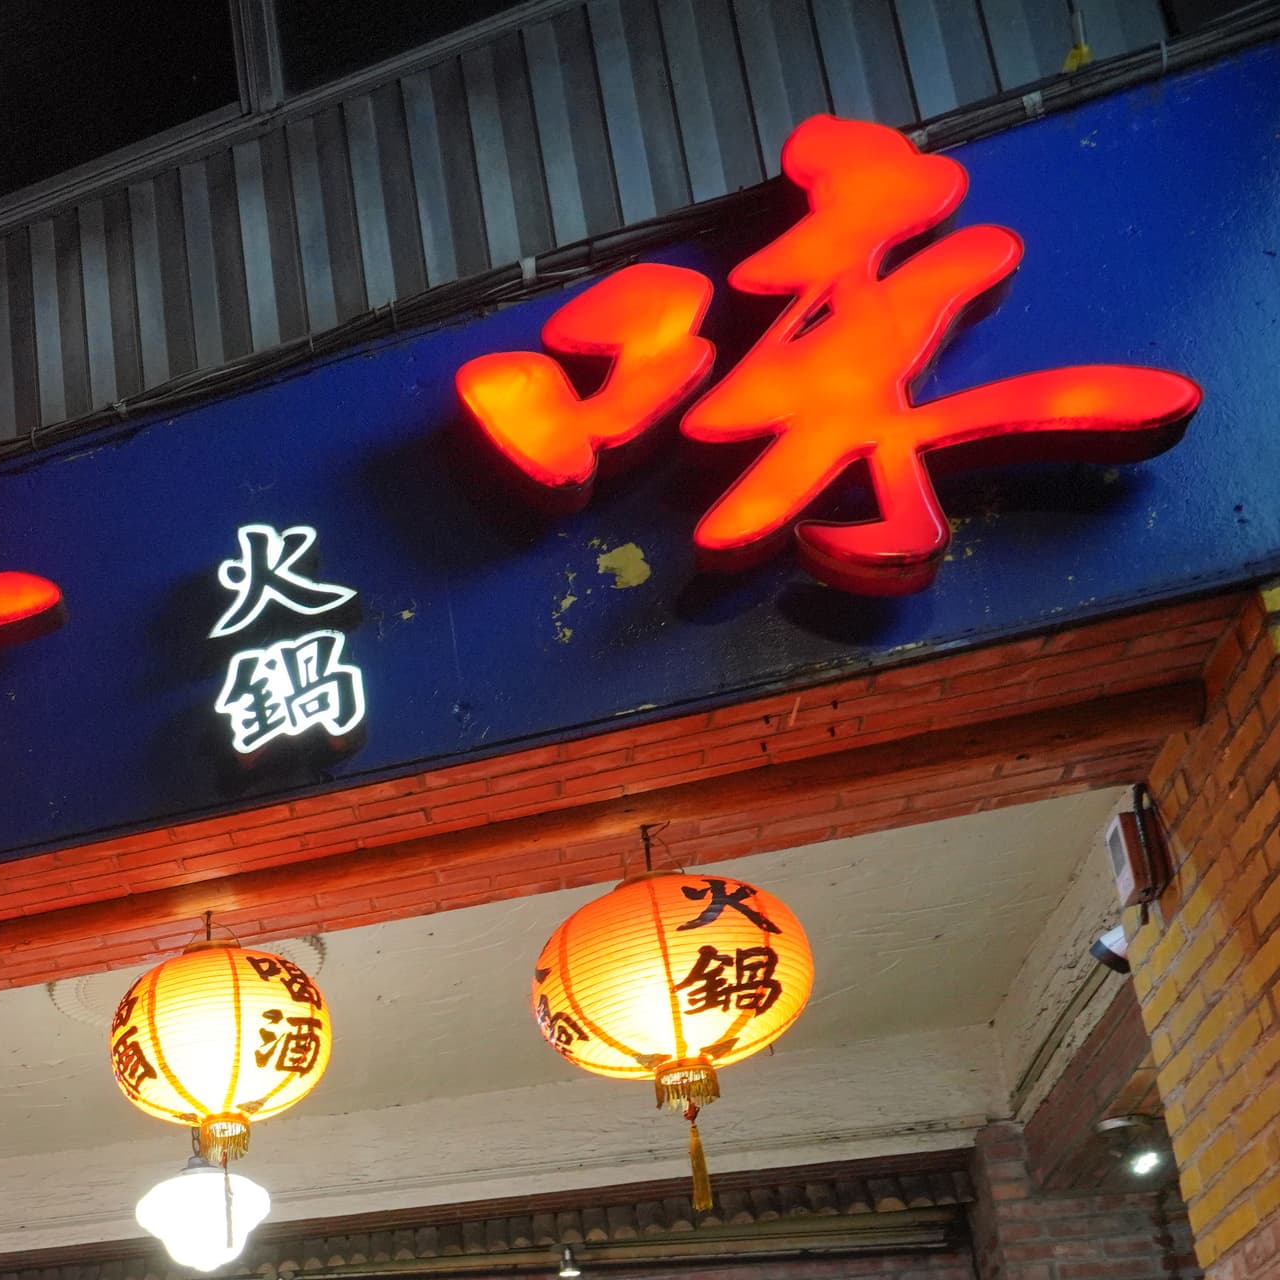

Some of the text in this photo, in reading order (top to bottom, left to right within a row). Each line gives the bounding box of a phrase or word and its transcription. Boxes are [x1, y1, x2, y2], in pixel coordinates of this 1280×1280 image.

[209, 524, 366, 754] 火鍋
[245, 954, 324, 1077] 喝酒
[676, 878, 784, 1018] 火鍋
